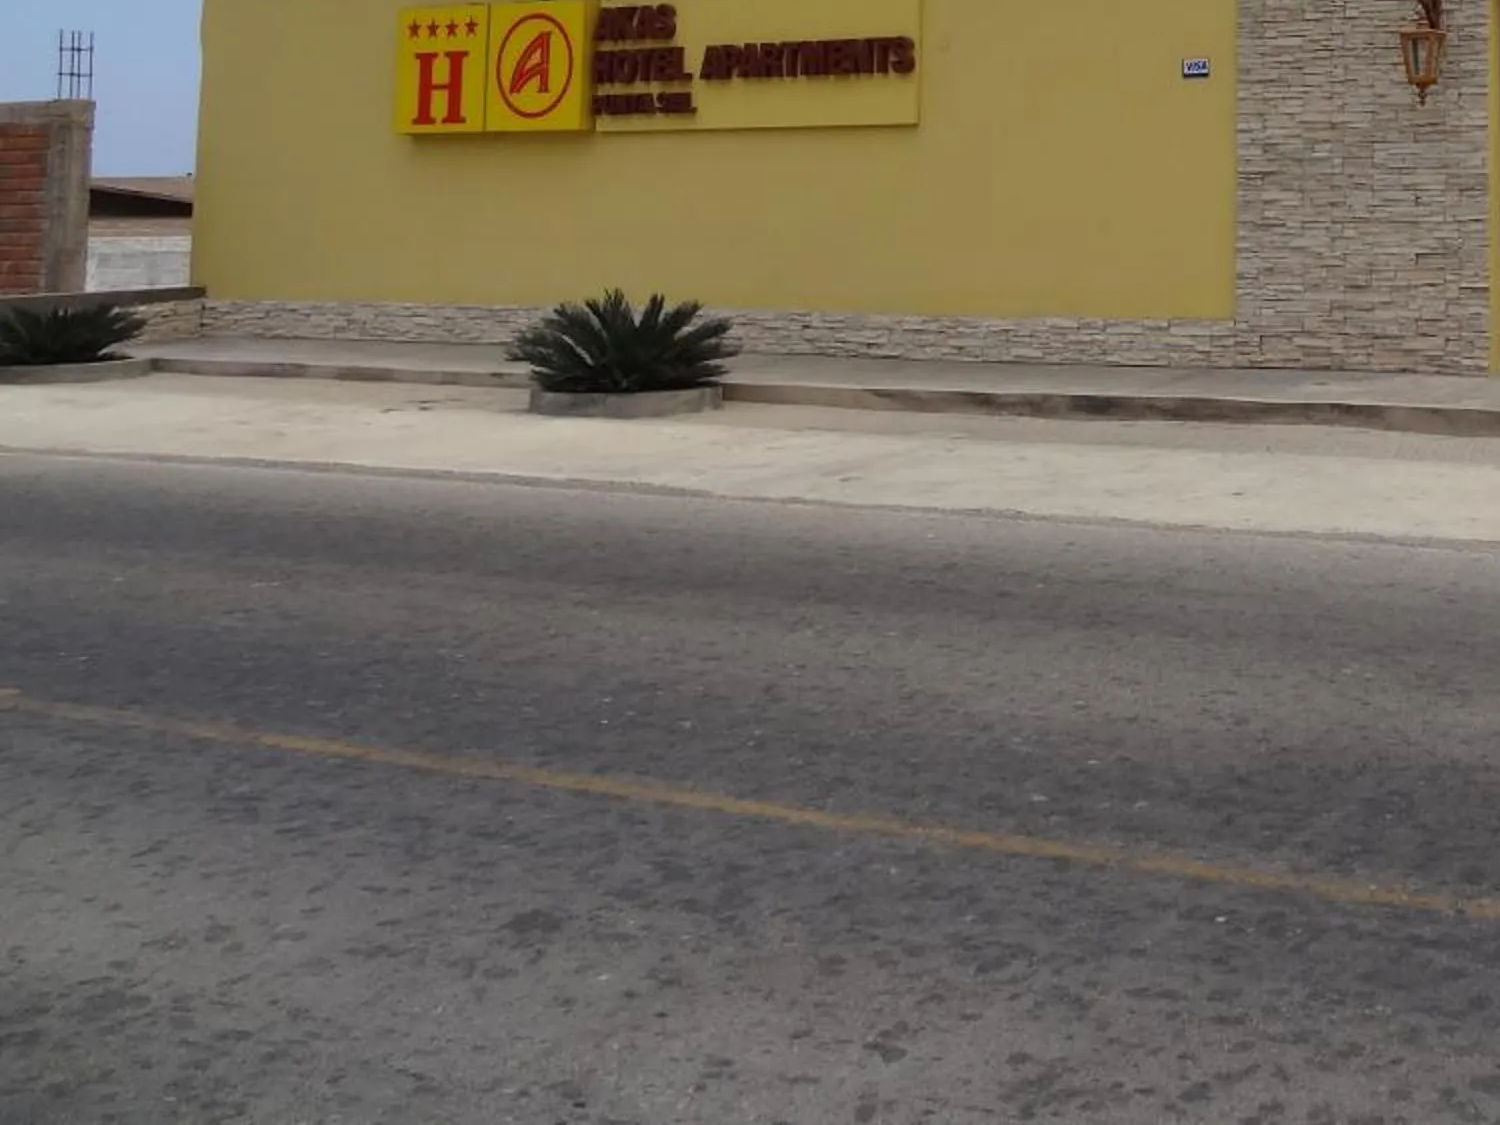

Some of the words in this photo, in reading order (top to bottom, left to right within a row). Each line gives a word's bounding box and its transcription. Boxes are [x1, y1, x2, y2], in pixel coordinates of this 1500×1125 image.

[509, 31, 552, 94] A
[592, 46, 693, 83] HOTEL
[700, 36, 915, 80] APARTMENTS
[1186, 61, 1207, 71] VISA
[412, 50, 469, 125] H
